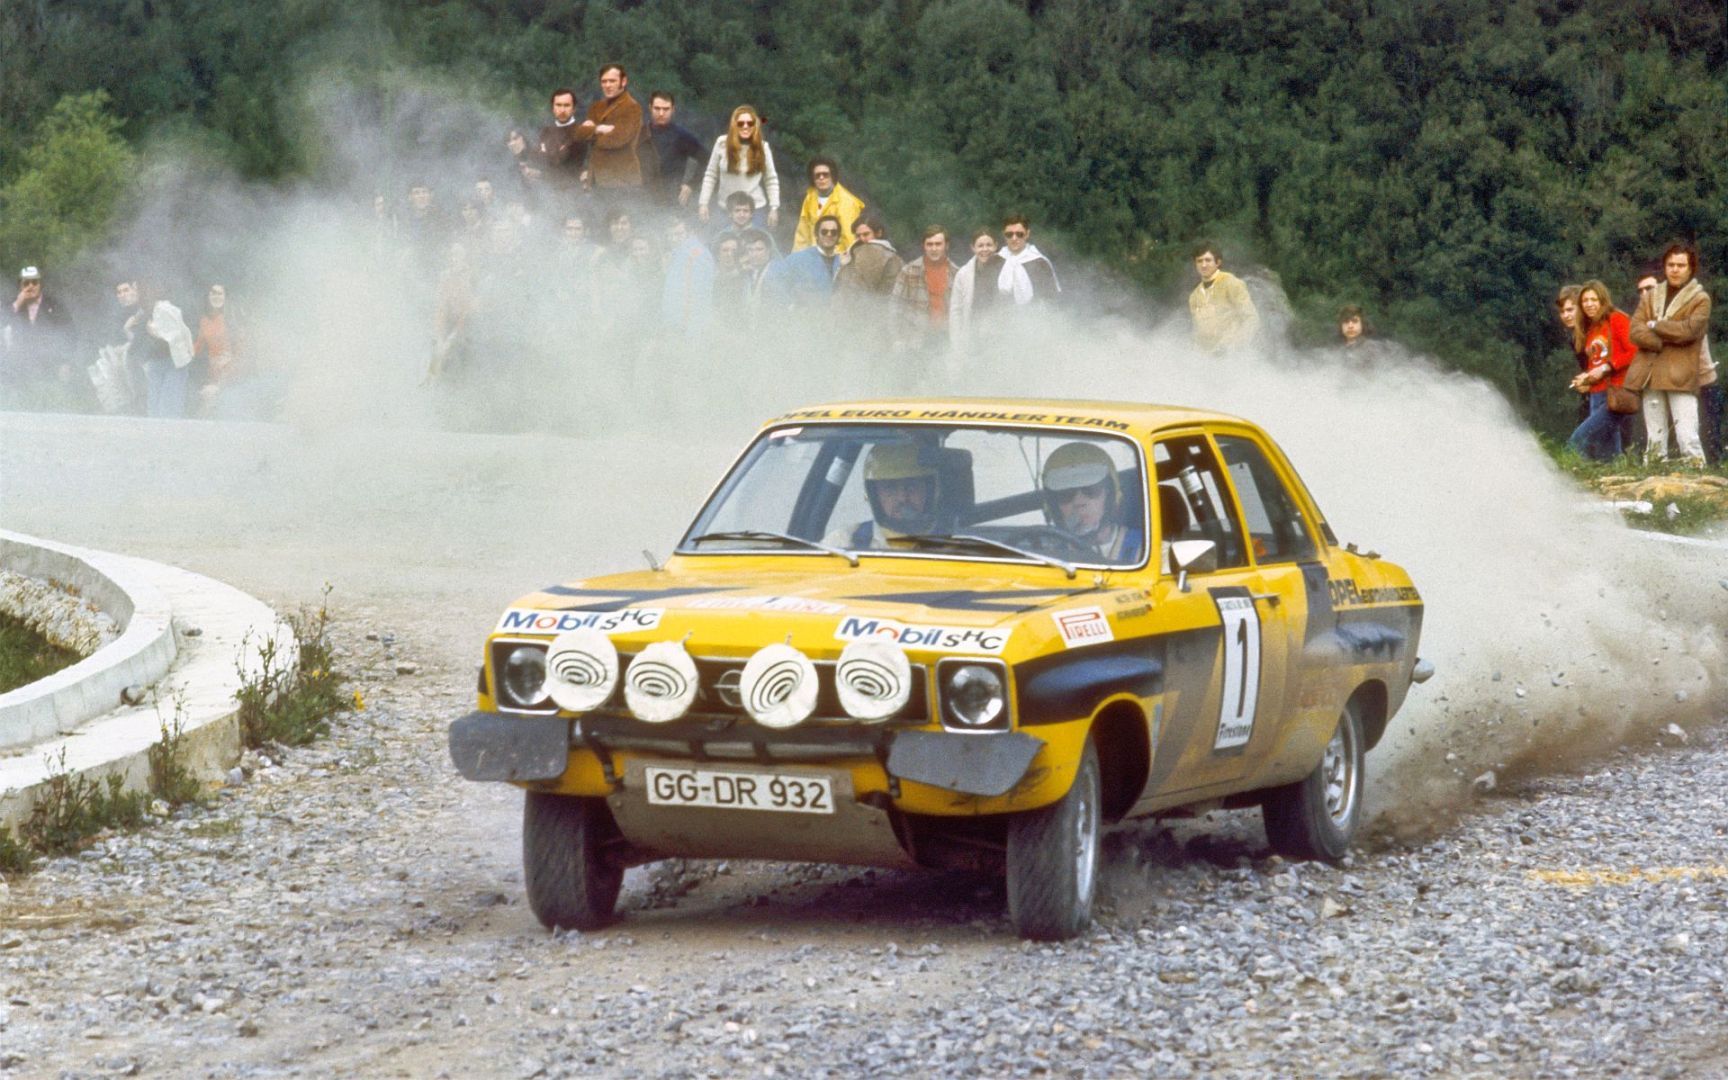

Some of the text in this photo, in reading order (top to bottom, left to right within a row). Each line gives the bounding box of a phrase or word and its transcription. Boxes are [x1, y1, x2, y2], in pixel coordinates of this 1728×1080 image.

[839, 410, 911, 418] EURO
[1052, 415, 1130, 430] TEAM
[502, 611, 601, 630] Mobil
[1059, 612, 1107, 640] PIRELLI
[1237, 617, 1248, 719] 1
[654, 772, 827, 809] GG-DR 932
